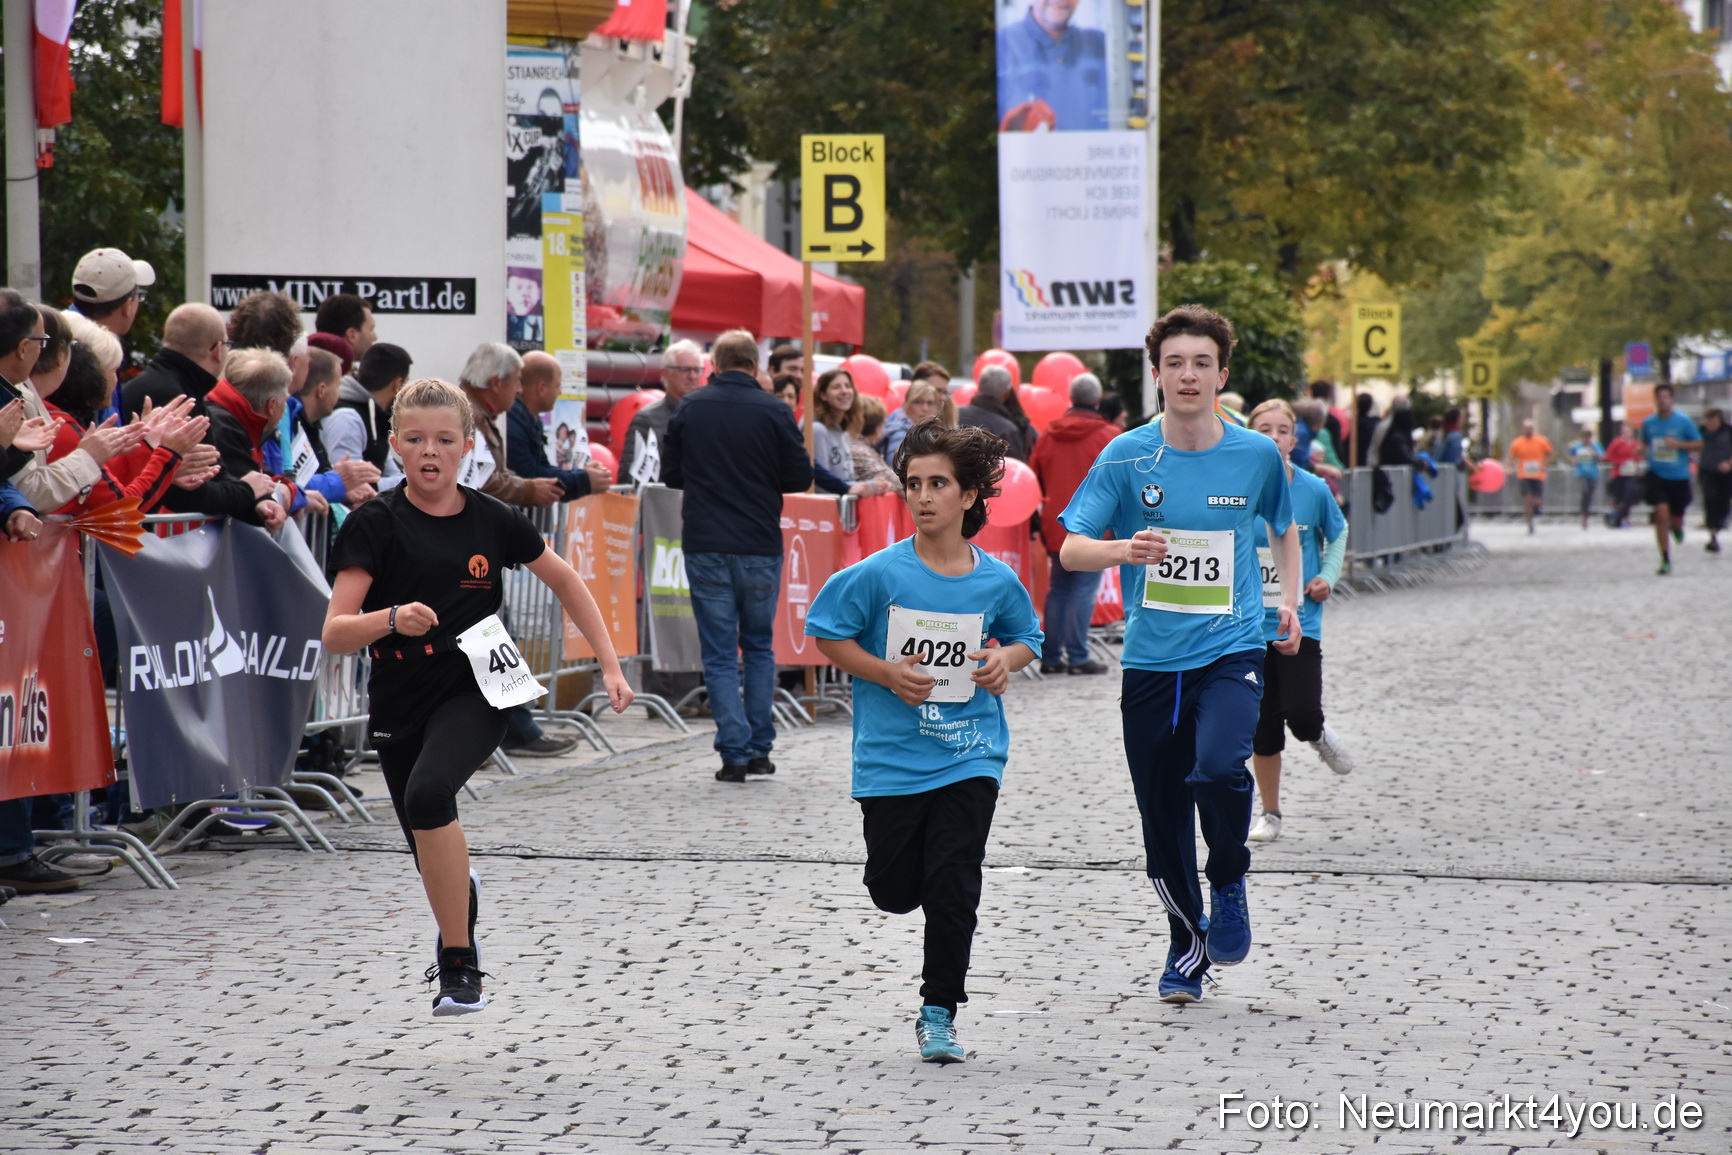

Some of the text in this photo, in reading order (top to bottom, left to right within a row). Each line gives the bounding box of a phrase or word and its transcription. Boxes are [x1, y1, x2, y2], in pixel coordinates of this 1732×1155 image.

[811, 141, 875, 163] Block
[823, 174, 864, 233] B
[1364, 325, 1388, 359] C
[1472, 362, 1490, 387] D
[1207, 496, 1247, 507] BOCK
[1142, 510, 1164, 518] PARTL
[1179, 538, 1209, 547] BOCK
[1158, 554, 1220, 582] 5213
[1261, 565, 1280, 584] 02
[1263, 590, 1282, 598] bienn
[925, 620, 958, 630] BOCK
[900, 637, 967, 668] 4028
[501, 673, 531, 697] Anton
[918, 703, 944, 721] 18.
[919, 719, 970, 731] Neumarkter
[919, 728, 962, 742] Stadtlauf
